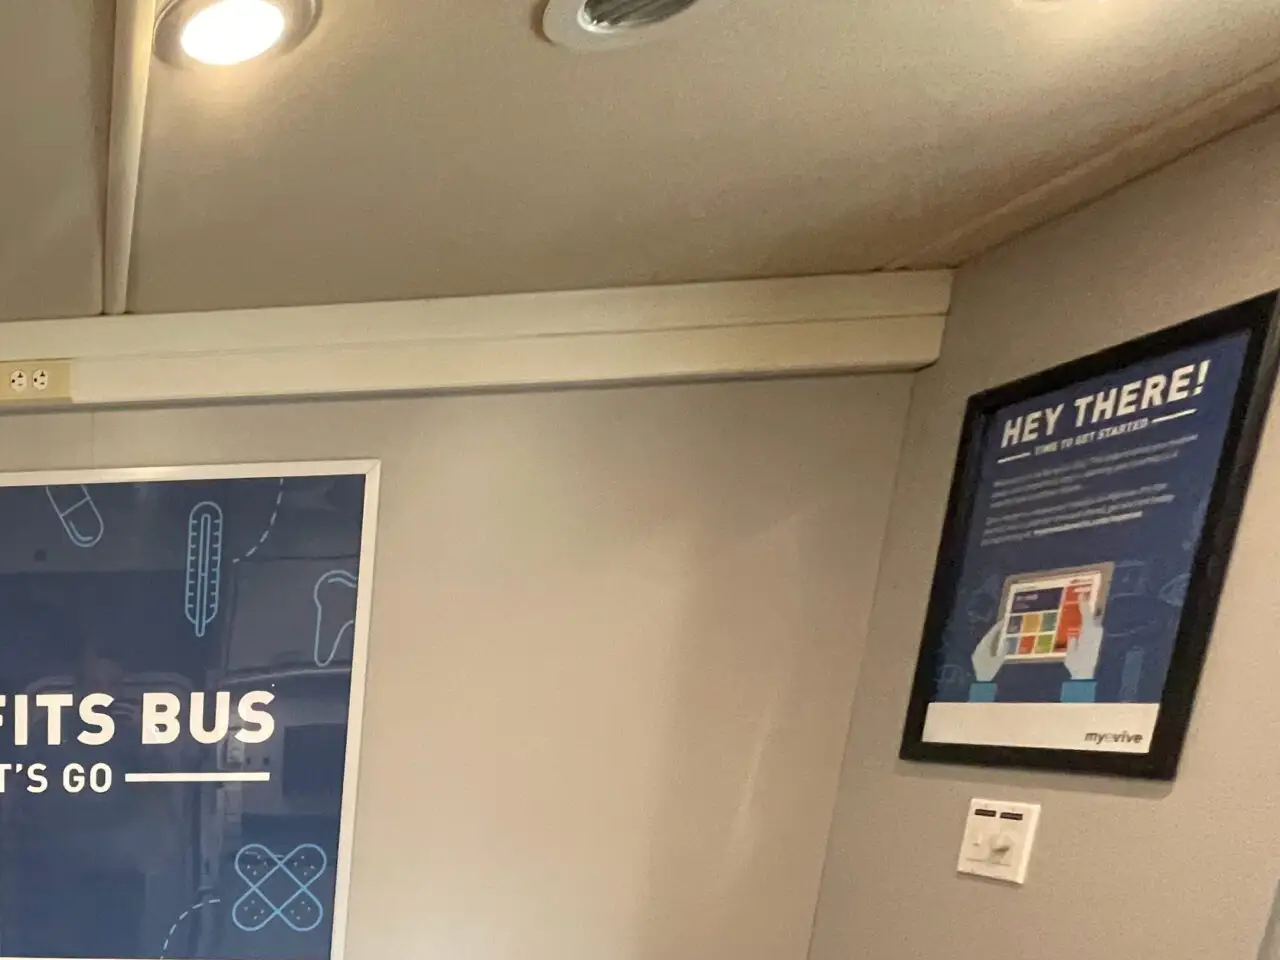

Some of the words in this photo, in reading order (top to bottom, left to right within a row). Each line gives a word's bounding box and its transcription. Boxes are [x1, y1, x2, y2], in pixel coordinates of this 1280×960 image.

[1001, 403, 1065, 448] HEY
[1074, 359, 1209, 426] THERE!
[1060, 437, 1074, 450] TO
[1097, 418, 1149, 440] STARTED
[140, 690, 276, 745] BUS
[61, 762, 113, 794] GO
